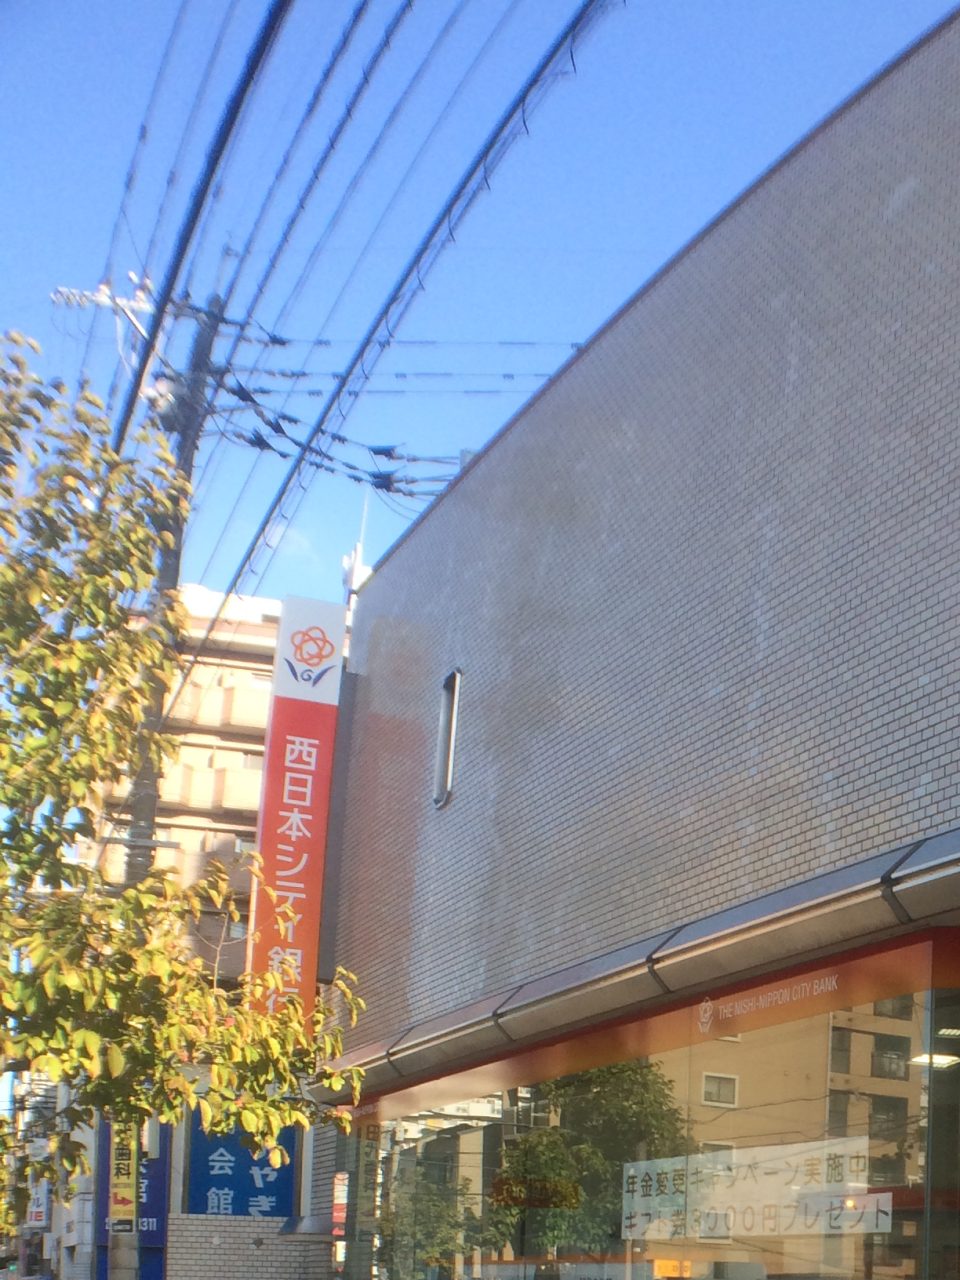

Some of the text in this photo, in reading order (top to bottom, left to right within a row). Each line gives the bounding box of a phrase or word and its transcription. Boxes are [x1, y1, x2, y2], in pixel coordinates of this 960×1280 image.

[718, 974, 839, 1020] THE NISHI-NIPPON CITY BANK
